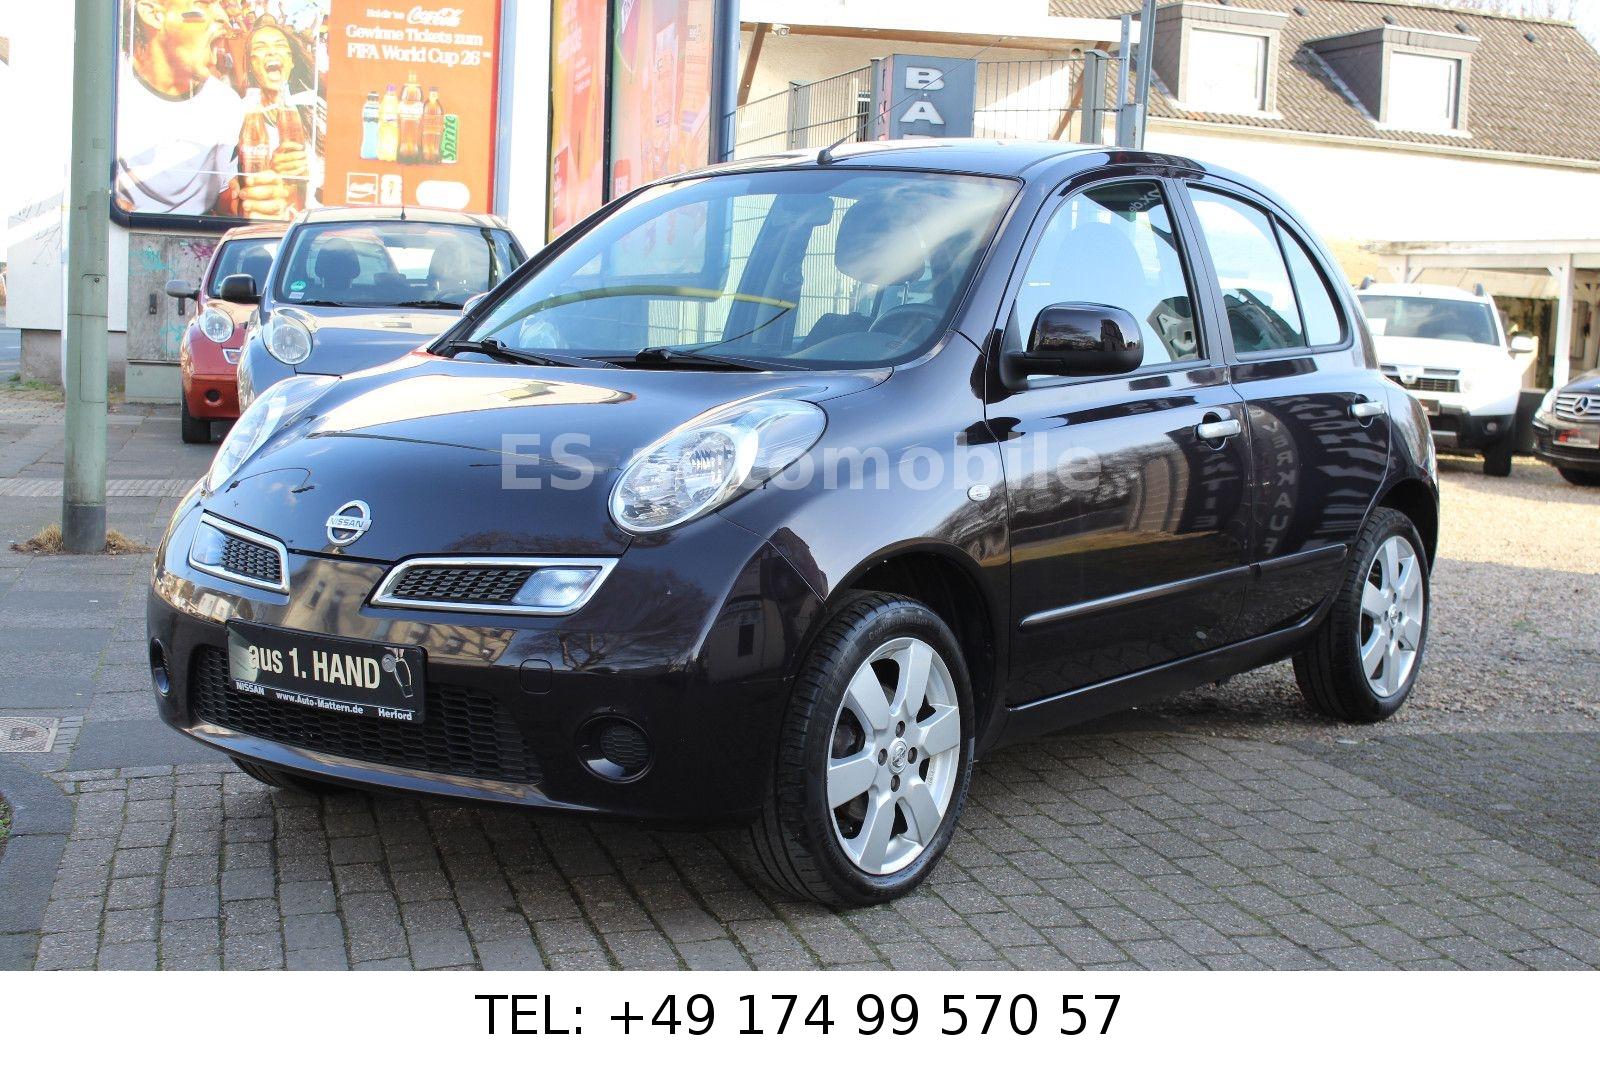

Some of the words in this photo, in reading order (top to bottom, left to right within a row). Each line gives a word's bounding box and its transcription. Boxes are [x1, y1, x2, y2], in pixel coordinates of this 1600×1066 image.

[345, 24, 404, 40] Gewinne
[405, 28, 452, 44] Tickets
[454, 33, 483, 46] zum
[347, 42, 379, 59] FIFA
[381, 44, 427, 63] World
[428, 47, 459, 67] Cup
[329, 517, 365, 528] NISSAN
[248, 645, 284, 674] aus
[288, 647, 307, 679] 1.
[312, 650, 381, 690] HAND
[235, 680, 265, 696] NISSAN
[276, 691, 364, 715] www.Auto-Mattern.de
[378, 708, 413, 721] Herford
